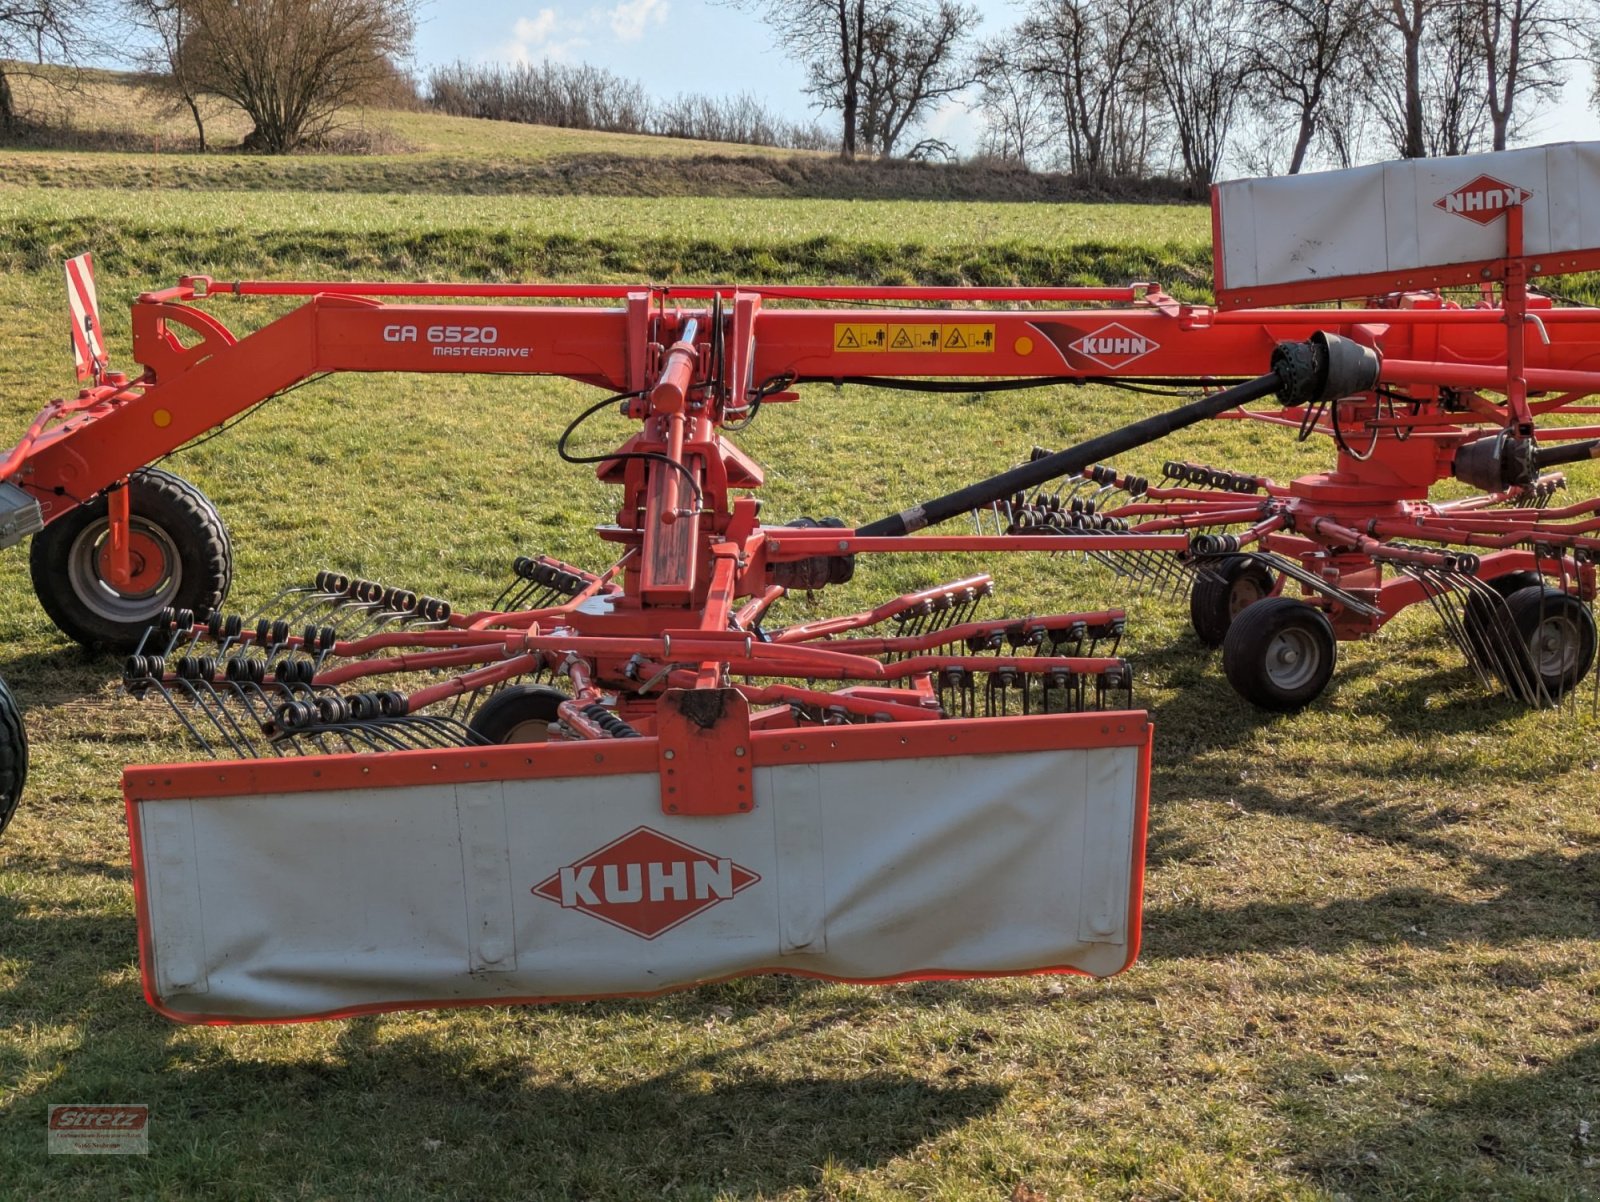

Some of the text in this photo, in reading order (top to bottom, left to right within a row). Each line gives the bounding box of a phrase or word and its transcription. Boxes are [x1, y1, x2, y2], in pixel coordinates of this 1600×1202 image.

[1445, 188, 1521, 213] KUHN
[383, 325, 498, 343] GA 6520
[433, 346, 529, 357] MASTERDRIVE
[1082, 337, 1146, 354] KUHN
[559, 858, 734, 907] KUHN
